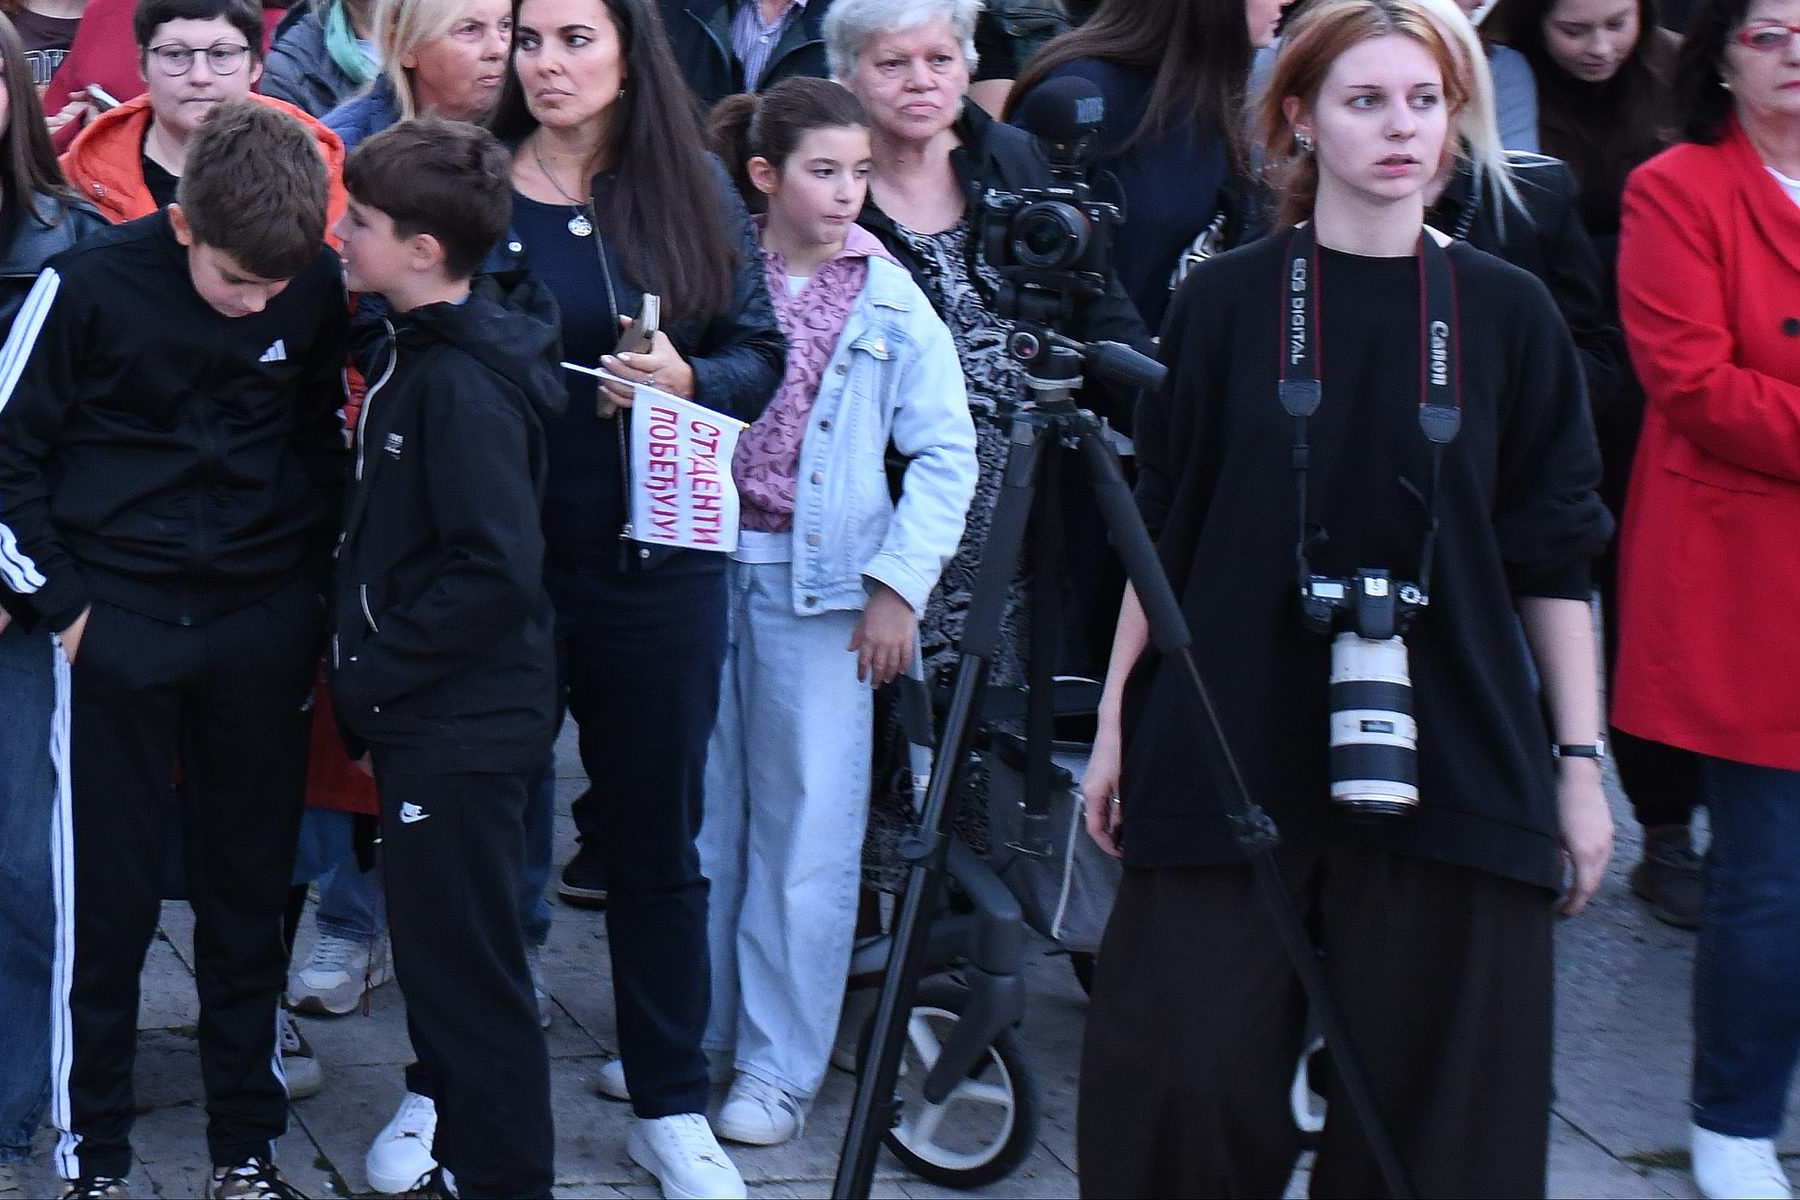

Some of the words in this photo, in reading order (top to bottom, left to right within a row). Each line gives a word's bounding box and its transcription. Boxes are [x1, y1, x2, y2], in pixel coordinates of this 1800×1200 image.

[1291, 258, 1307, 291] EOS
[1291, 297, 1306, 365] DIGITAL
[1430, 320, 1450, 386] Canon
[685, 420, 723, 545] СТУДЕНТИ
